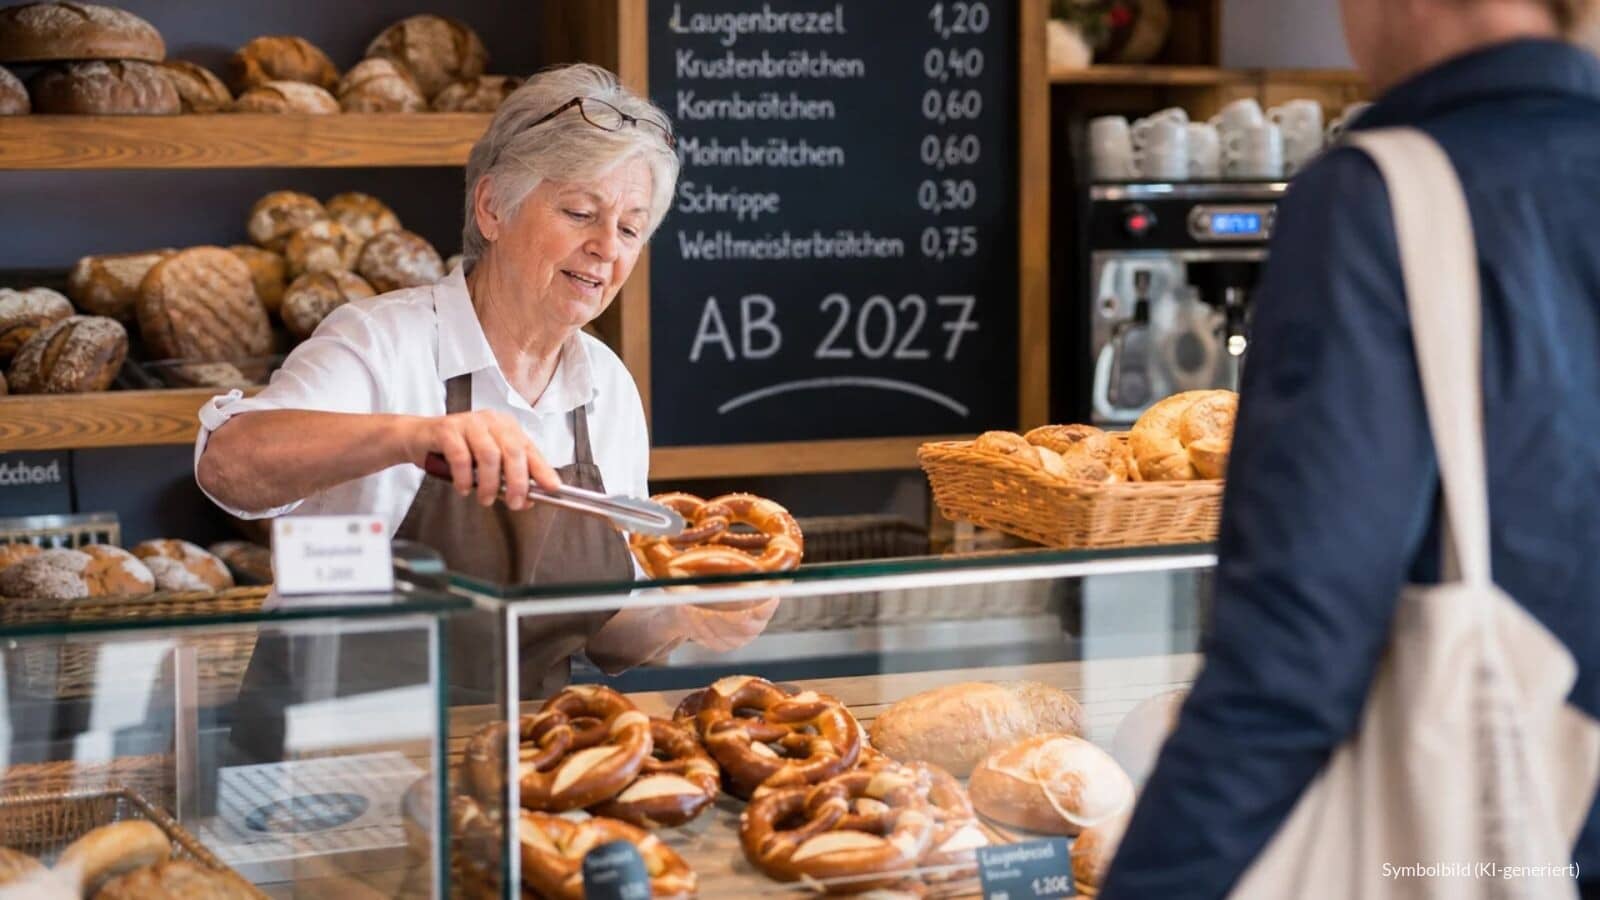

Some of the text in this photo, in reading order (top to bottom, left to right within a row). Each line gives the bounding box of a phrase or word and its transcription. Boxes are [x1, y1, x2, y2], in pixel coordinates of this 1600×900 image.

[672, 3, 989, 46] Laugenbrezel 1,20
[676, 48, 983, 81] Krustenbrötchen 0,40
[677, 89, 982, 122] Kornbrötchen 0,60
[679, 135, 980, 169] Mohnbrötchen 0,60
[678, 180, 976, 221] Schrippe 0,30
[678, 227, 977, 260] Weltmeisterbrötchen 0,75
[689, 293, 979, 362] AB 2027
